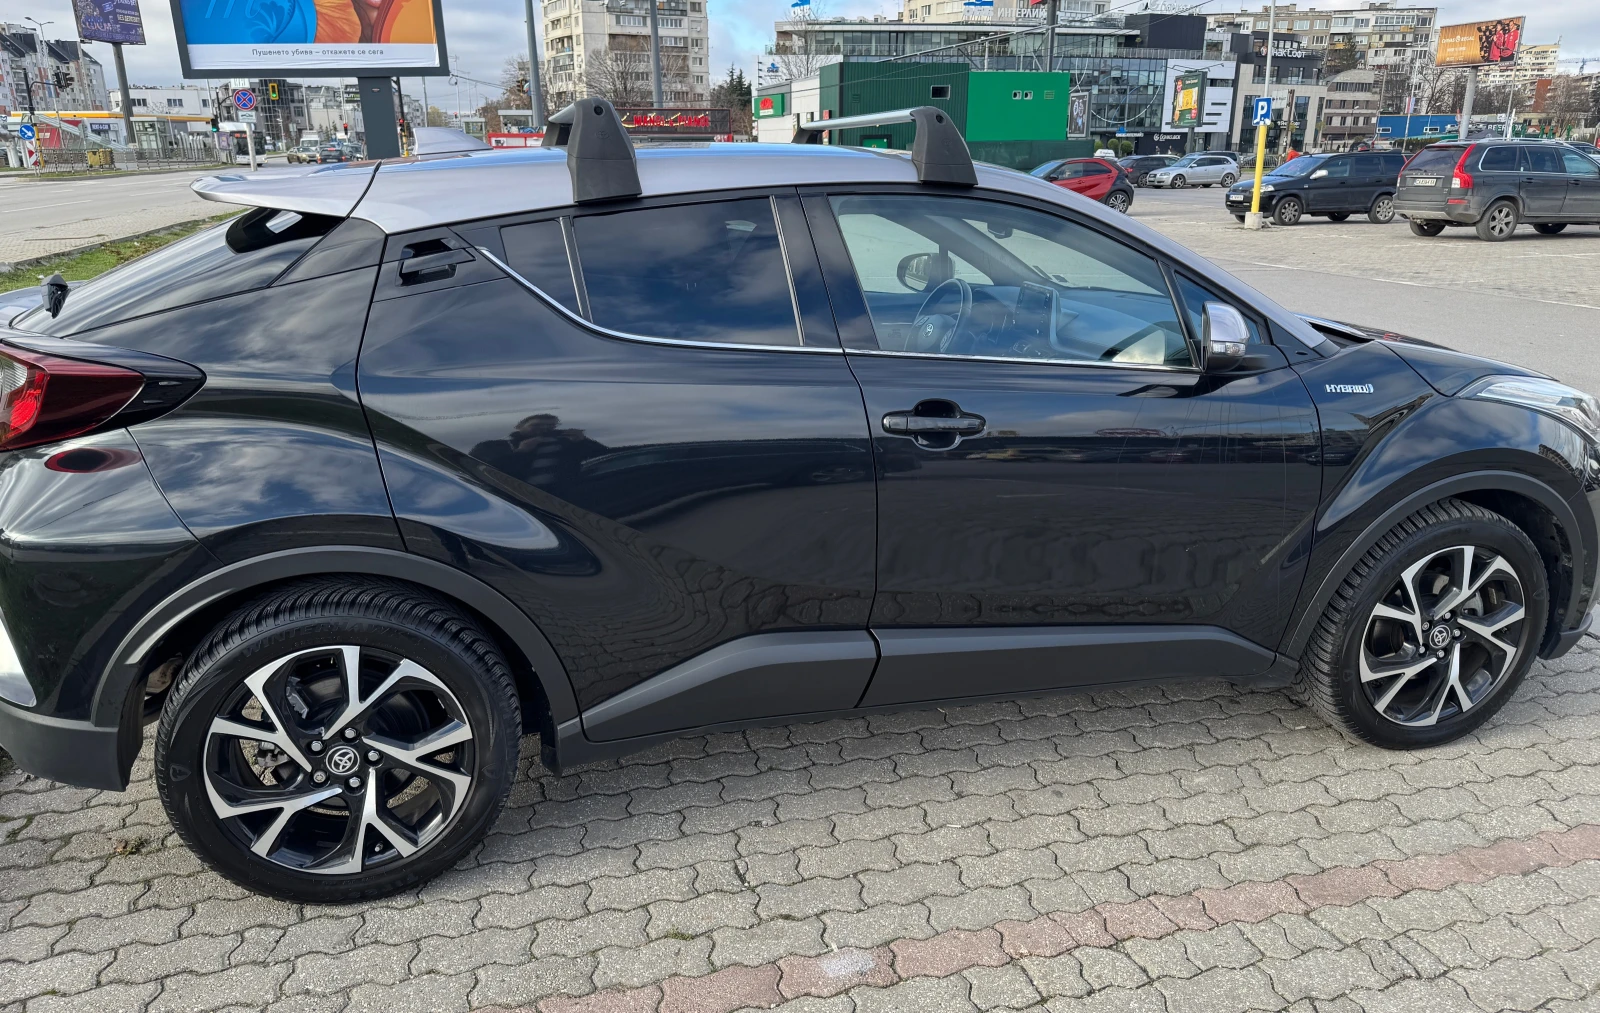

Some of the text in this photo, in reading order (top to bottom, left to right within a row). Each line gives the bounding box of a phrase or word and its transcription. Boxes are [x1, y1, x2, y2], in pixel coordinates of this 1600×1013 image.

[252, 48, 289, 56] Пушенето
[292, 48, 313, 56] убива
[1325, 384, 1367, 394] HYBRID
